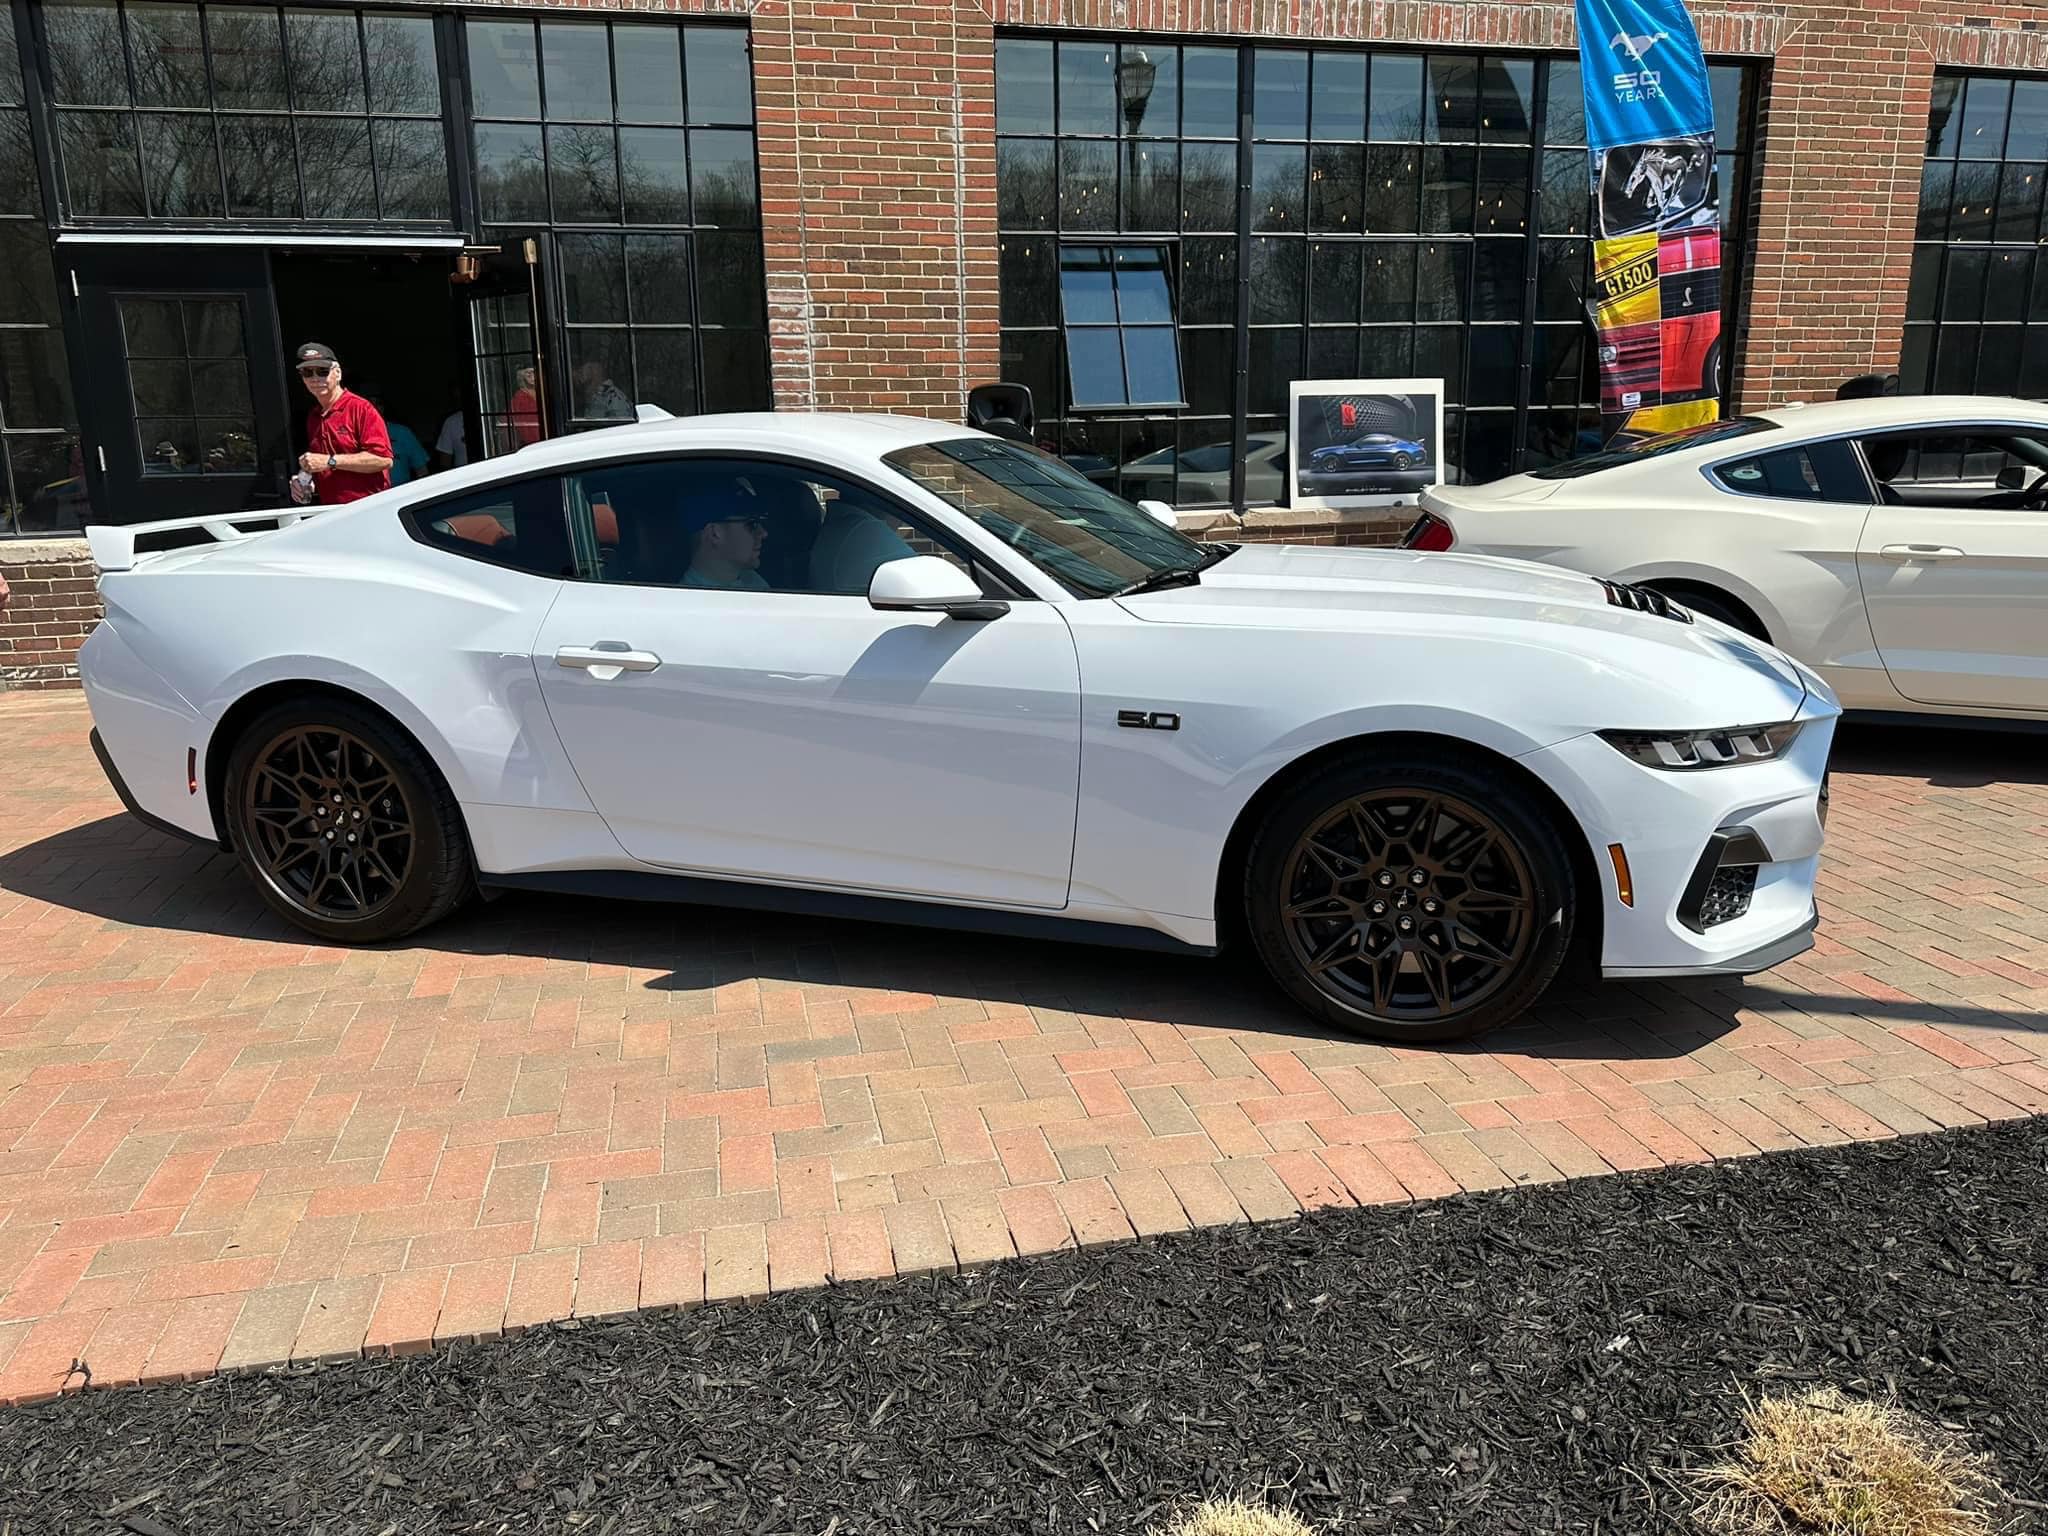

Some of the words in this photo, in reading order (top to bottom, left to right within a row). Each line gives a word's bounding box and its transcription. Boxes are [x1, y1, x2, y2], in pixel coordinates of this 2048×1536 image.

[1613, 71, 1661, 90] 50
[1615, 87, 1664, 104] YEARS
[1605, 262, 1652, 297] GT500
[1117, 709, 1180, 731] 5.0
